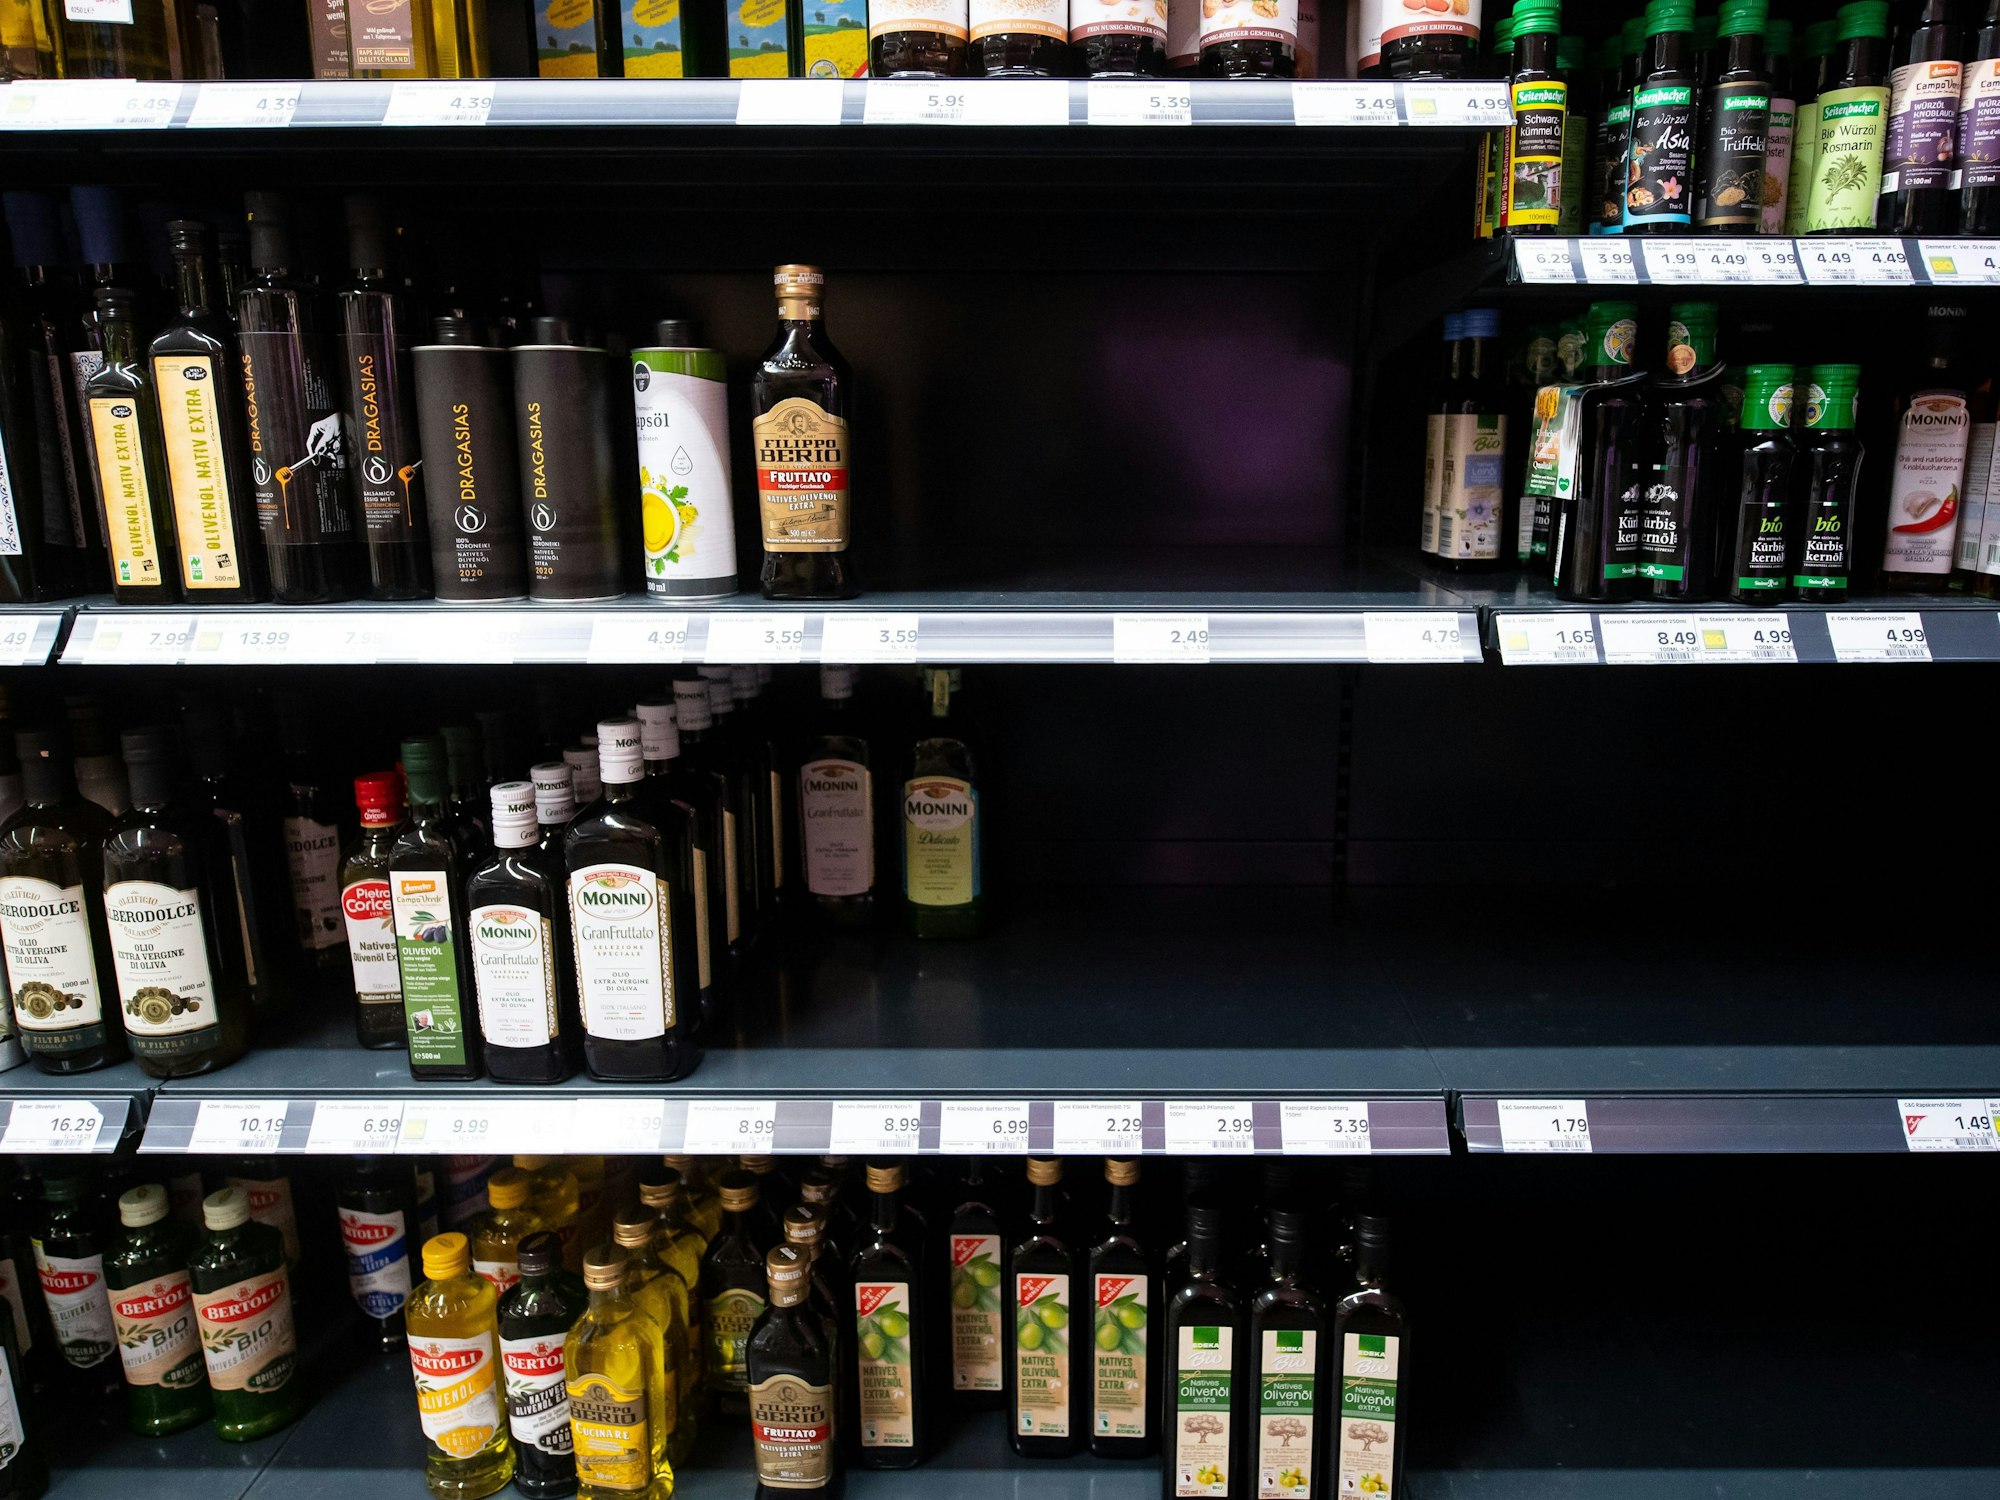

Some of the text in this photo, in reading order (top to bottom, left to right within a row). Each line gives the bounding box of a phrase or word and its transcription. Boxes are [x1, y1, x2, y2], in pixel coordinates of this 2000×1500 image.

[1408, 24, 1463, 32] HOCH ERHITZBAR
[1150, 96, 1191, 108] 5.39
[1356, 98, 1395, 109] 3.49
[1518, 90, 1565, 104] Seitenbacher
[1634, 90, 1690, 108] Seitenbacher
[1725, 97, 1768, 108] Seitenbacher
[1467, 98, 1508, 110] 4.99
[1824, 102, 1878, 119] Seitenbacher
[1914, 101, 1944, 110] WÜRZÖL
[1524, 114, 1560, 126] Schwarz-
[1636, 114, 1689, 128] Bio Würzöl
[1520, 126, 1550, 136] kümmel
[1720, 127, 1736, 136] Bio
[1821, 124, 1877, 139] Bio Würzöl
[1656, 126, 1690, 150] Asia
[1720, 136, 1766, 151] Trüffelöl
[1822, 140, 1872, 154] Rosmarin
[1536, 254, 1570, 264] 6.29
[1598, 254, 1632, 264] 3.99
[1662, 254, 1696, 264] 1.99
[1711, 254, 1744, 264] 4.49
[1762, 254, 1796, 264] 9.99
[1817, 253, 1851, 263] 4.49
[1872, 253, 1906, 263] 4.49
[242, 354, 262, 452] DRAGASIAS
[358, 354, 382, 451] DRAGASIAS
[186, 388, 206, 433] EXTRA
[636, 413, 670, 430] apsöl
[1911, 414, 1962, 425] MONINI
[113, 423, 130, 461] EXTRA
[764, 440, 836, 448] FILIPPO
[1473, 436, 1500, 450] Bio
[453, 404, 476, 499] DRAGASIAS
[528, 402, 547, 498] DRAGASIAS
[760, 449, 841, 463] BERIO
[192, 438, 211, 478] NATIV
[120, 464, 136, 498] NATIV
[770, 471, 831, 483] FRUTTATO
[766, 494, 797, 503] NATIVES
[789, 502, 815, 511] EXTRA
[1760, 516, 1782, 533] bio
[1815, 516, 1840, 532] bio
[1752, 541, 1784, 552] Kürbis
[1807, 541, 1843, 551] Kürbis
[1751, 551, 1784, 562] kernöl
[1806, 551, 1842, 562] kernöl
[460, 569, 482, 577] 2020
[150, 633, 188, 645] 7.99
[240, 632, 289, 645] 13.99
[648, 631, 686, 644] 4.99
[764, 630, 802, 643] 3.59
[879, 630, 918, 643] 3.59
[1171, 630, 1209, 644] 2.49
[1422, 630, 1460, 643] 4.79
[1556, 630, 1594, 644] 1.65
[1658, 632, 1696, 645] 8.49
[1754, 630, 1791, 642] 4.99
[1887, 629, 1924, 642] 4.99
[809, 780, 858, 791] MONINI
[908, 801, 968, 816] MONINI
[356, 888, 390, 899] Pietro
[404, 883, 432, 893] demeter
[118, 897, 158, 906] OLEIFICIO
[346, 898, 391, 912] Corice
[583, 892, 646, 905] MONINI
[481, 928, 532, 938] MONINI
[582, 925, 653, 941] GranFruttato
[360, 942, 396, 951] Natives
[402, 946, 443, 955] OLIVENÖL
[143, 949, 184, 960] VERGINE
[354, 952, 385, 963] Olivenöl
[480, 953, 539, 966] GranFruttato
[140, 961, 166, 969] OLIVA
[51, 1118, 95, 1132] 16.29
[239, 1118, 284, 1132] 10.19
[363, 1118, 400, 1132] 6.99
[452, 1119, 488, 1133] 9.99
[739, 1120, 774, 1134] 8.99
[884, 1118, 920, 1132] 8.99
[993, 1120, 1028, 1134] 6.99
[1107, 1118, 1142, 1132] 2.29
[1217, 1118, 1252, 1132] 2.99
[1333, 1119, 1368, 1133] 3.39
[1552, 1118, 1586, 1132] 1.79
[1955, 1116, 1990, 1130] 1.49
[207, 1284, 282, 1320] BERTOLLI
[956, 1314, 988, 1323] NATIVES
[151, 1316, 188, 1348] BIO
[237, 1319, 272, 1351] BIO
[956, 1337, 982, 1345] EXTRA
[412, 1354, 476, 1370] BERTOLLI
[508, 1353, 564, 1369] BERTO
[1022, 1356, 1055, 1366] NATIVES
[1099, 1356, 1133, 1367] NATIVES
[1188, 1352, 1223, 1367] Bio
[1272, 1355, 1306, 1370] Bio
[864, 1366, 898, 1376] NATIVES
[1022, 1367, 1060, 1378] OLIVENÖL
[1354, 1359, 1389, 1374] Bio
[1099, 1368, 1137, 1379] OLIVENÖL
[864, 1376, 903, 1387] OLIVENÖL
[1022, 1379, 1047, 1388] EXTRA
[1099, 1380, 1124, 1390] EXTRA
[529, 1381, 566, 1404] NATIVES
[864, 1390, 890, 1399] EXTRA
[1181, 1386, 1229, 1397] Olivenöl
[1264, 1390, 1312, 1400] Olivenöl
[1355, 1386, 1384, 1395] Natives
[1345, 1393, 1394, 1406] Olivenöl
[570, 1401, 631, 1414] FILIPPO
[759, 1404, 820, 1412] FILIPPO
[1358, 1404, 1380, 1412] extra
[570, 1407, 636, 1424] BERIO
[755, 1411, 825, 1423] BERIO
[576, 1422, 629, 1440] CUCINARE
[764, 1427, 816, 1438] FRUTTATO
